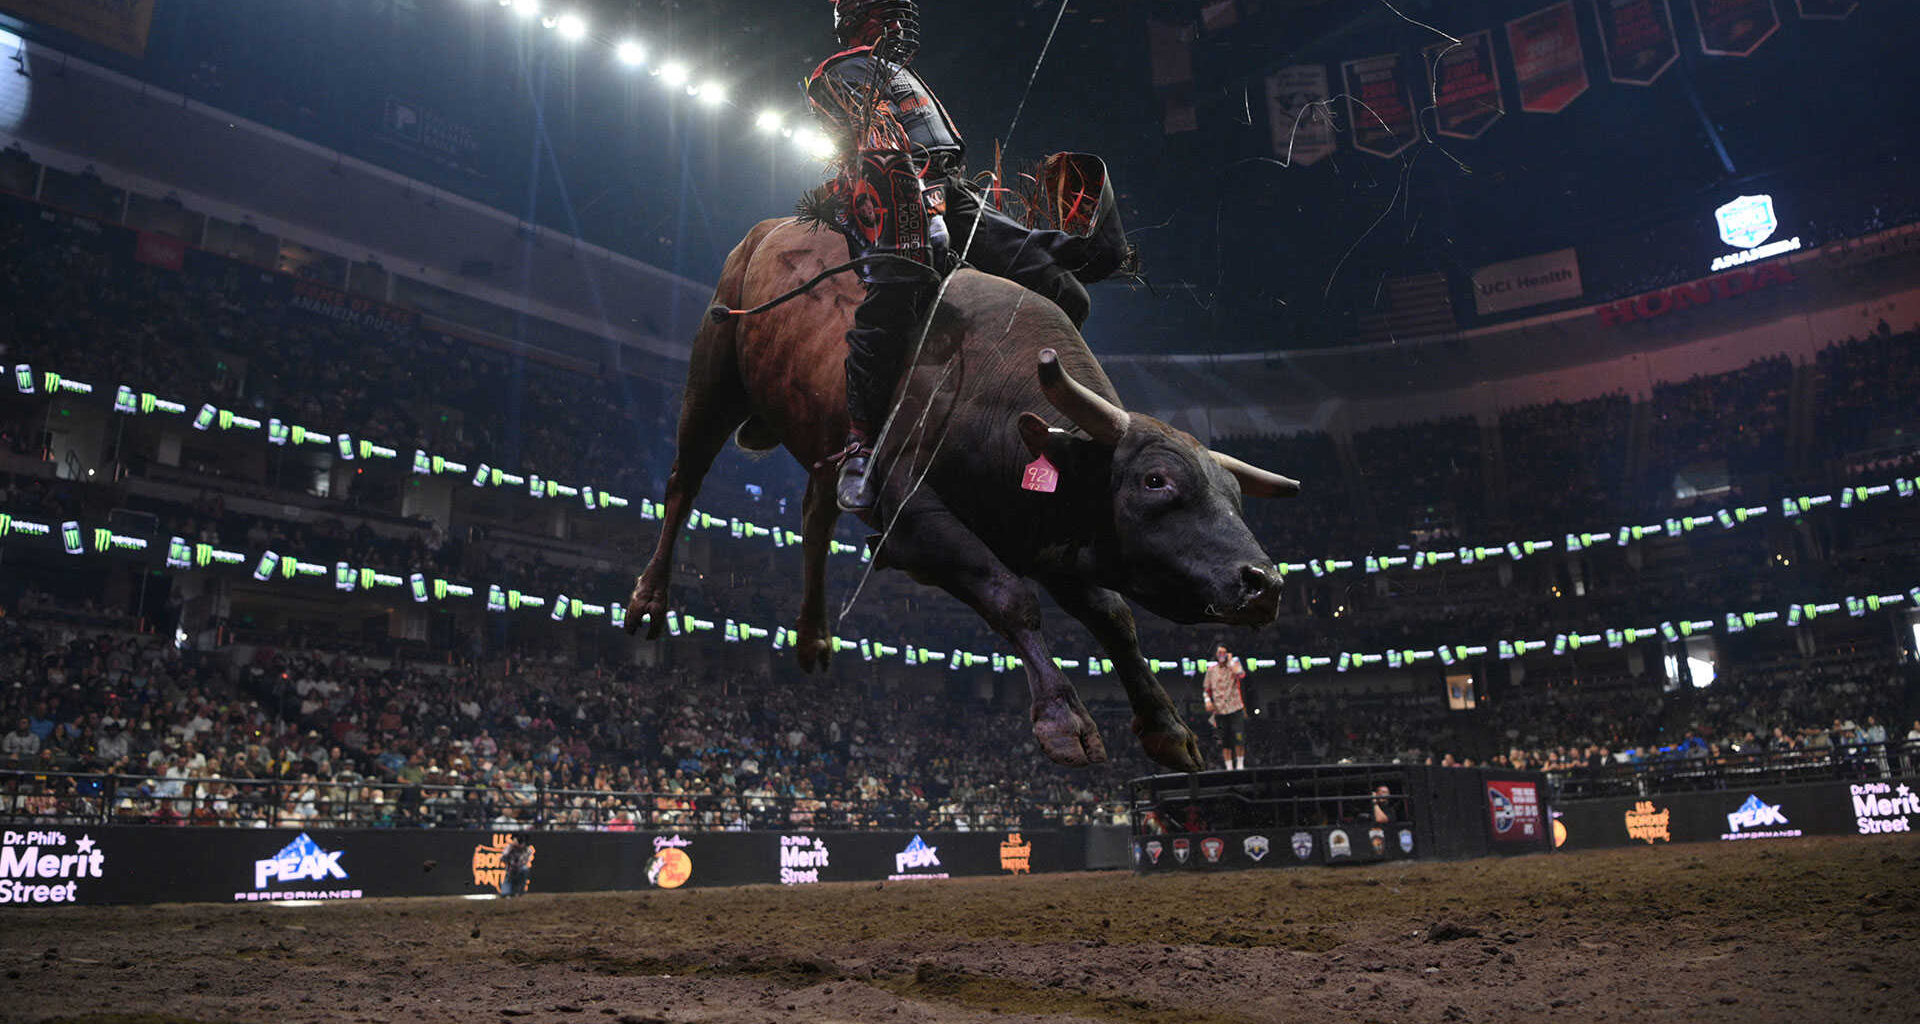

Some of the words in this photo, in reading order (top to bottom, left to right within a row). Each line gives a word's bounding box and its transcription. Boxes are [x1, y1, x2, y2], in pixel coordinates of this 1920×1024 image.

[1481, 281, 1512, 296] UCI
[1517, 268, 1572, 289] Health
[1598, 262, 1797, 328] HONDA
[1028, 467, 1054, 484] 921
[1853, 793, 1920, 817] Merit
[1727, 804, 1789, 833] PEAK
[1857, 816, 1911, 834] Street
[0, 846, 105, 878] Merit
[780, 845, 830, 867] Merit
[896, 846, 941, 873] PEAK
[255, 850, 349, 889] PEAK
[0, 879, 78, 903] Street
[234, 889, 362, 901] PERFORMANCE
